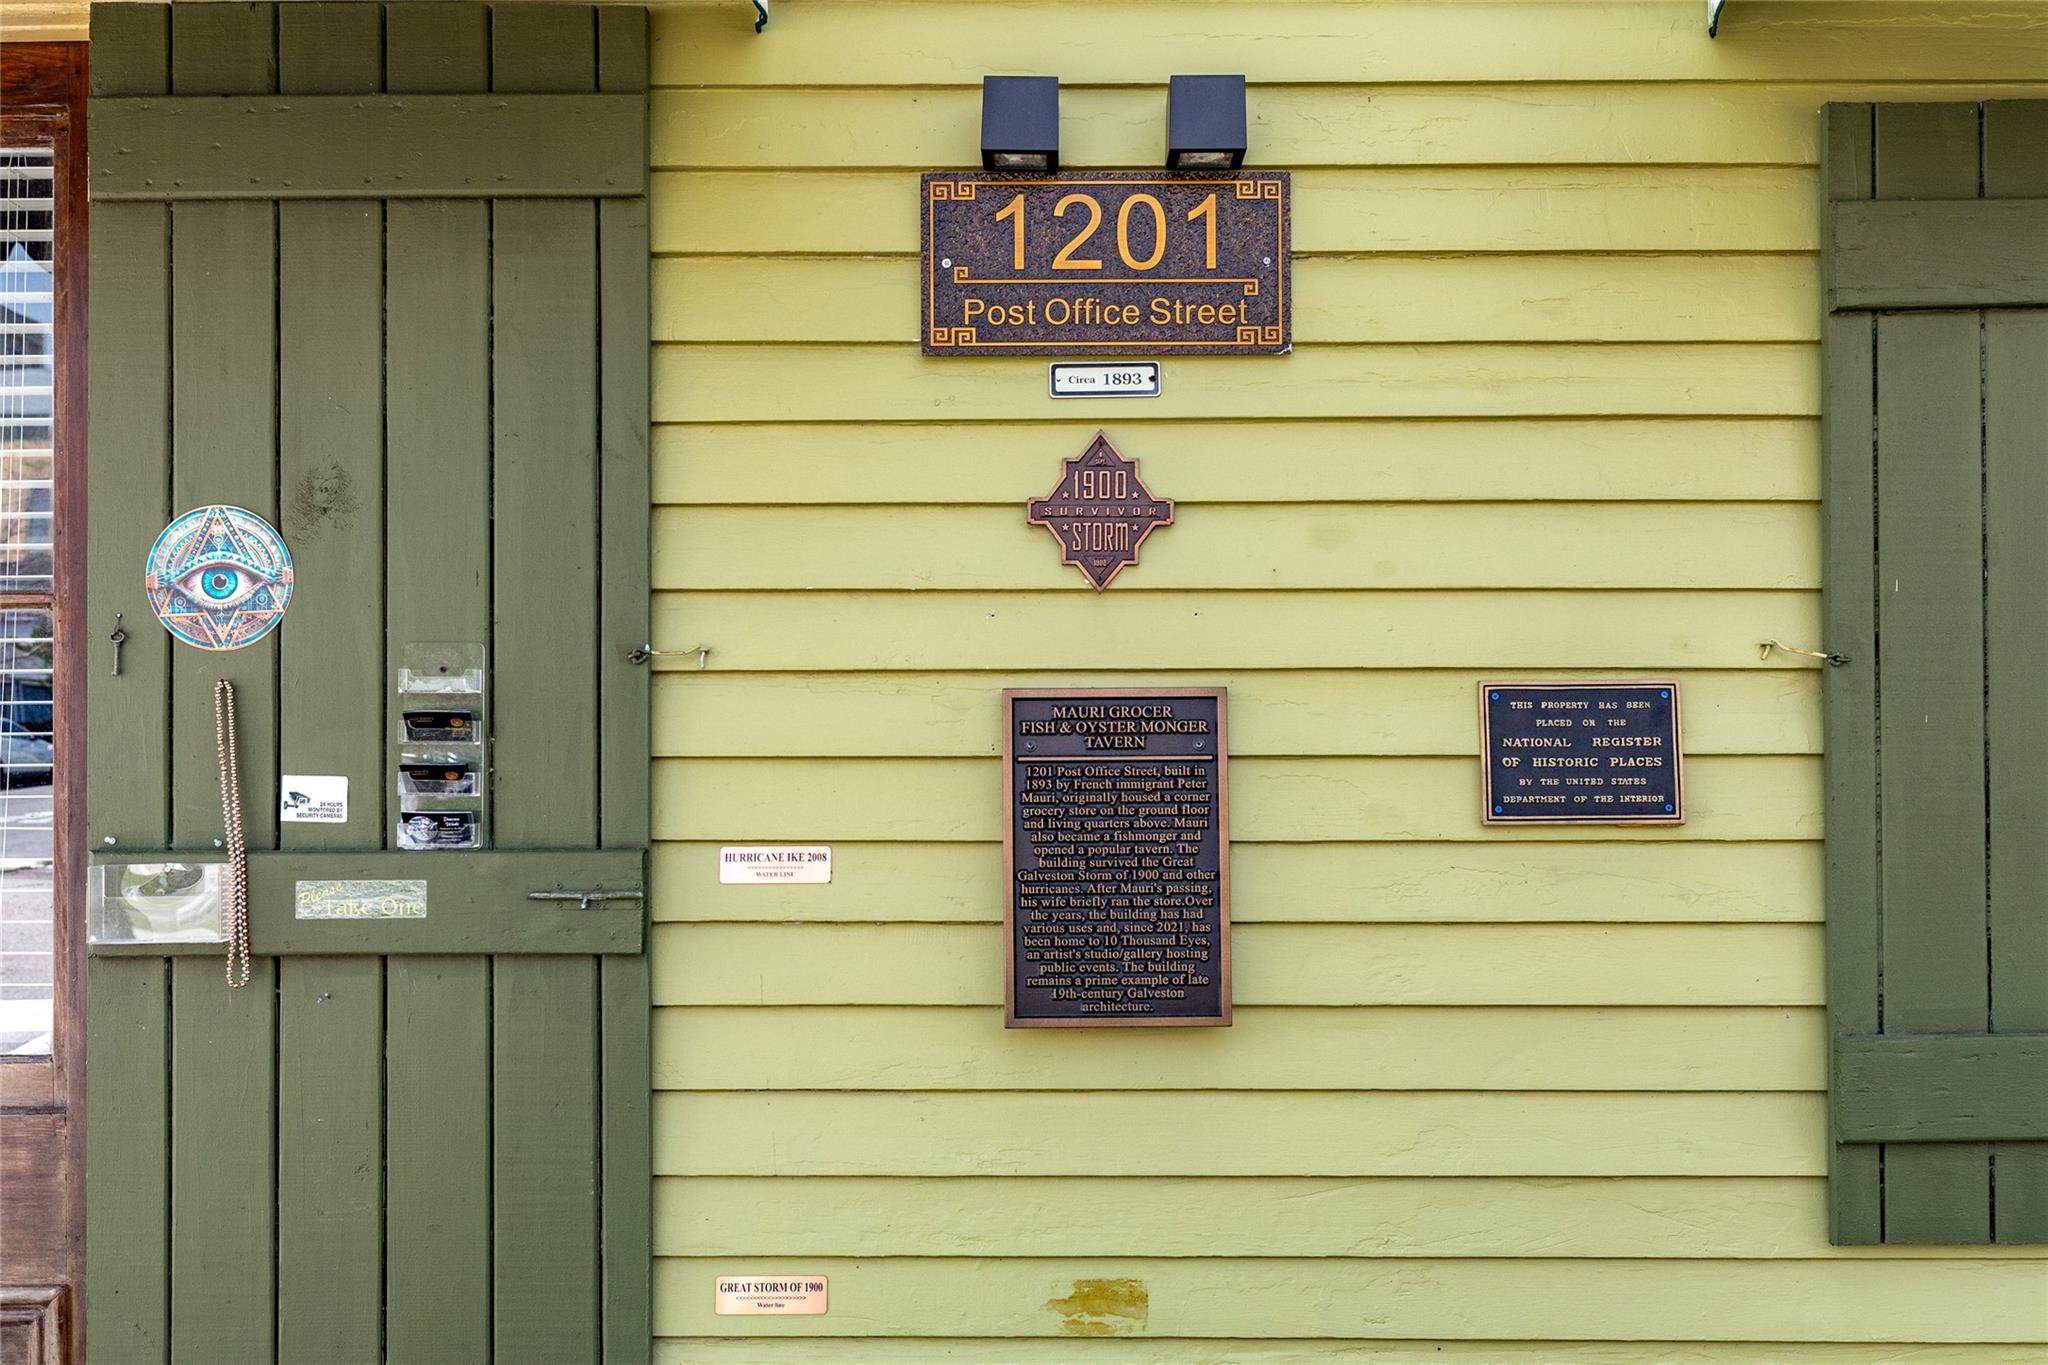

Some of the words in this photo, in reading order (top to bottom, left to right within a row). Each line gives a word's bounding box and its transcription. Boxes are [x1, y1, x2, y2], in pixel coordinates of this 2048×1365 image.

[995, 193, 1218, 270] 1201
[964, 298, 1036, 326] Post
[1045, 298, 1140, 326] Office
[1150, 298, 1248, 326] Street
[1068, 375, 1095, 385] Circa
[1103, 372, 1142, 386] 1893
[1074, 471, 1126, 499] 1900
[1073, 522, 1128, 551] STORM
[1053, 706, 1104, 718] MAURI
[1109, 706, 1172, 718] GROCER
[1021, 721, 1056, 733] FISH
[1060, 721, 1072, 733] &
[1076, 721, 1136, 733] OYSTER
[1141, 721, 1208, 733] MONGER
[1084, 736, 1145, 748] TAVERN
[1503, 738, 1572, 747] NATIONAL
[1592, 737, 1662, 746] REGISTER
[1502, 758, 1521, 767] OF
[1533, 758, 1598, 767] HISTORIC
[1610, 757, 1662, 766] PLACES
[1027, 767, 1052, 776] 1201
[1057, 767, 1081, 776] Post
[1085, 767, 1120, 776] Office
[1125, 767, 1161, 778] Street,
[1164, 766, 1190, 775] built
[1194, 766, 1204, 775] in
[1026, 780, 1051, 790] 1893
[1056, 779, 1069, 791] by
[1074, 779, 1113, 789] French
[1116, 779, 1174, 791] immigrant
[1177, 779, 1207, 788] Peter
[1022, 793, 1059, 804] Mauri,
[1063, 793, 1117, 804] originally
[1122, 792, 1160, 802] housed
[1594, 795, 1613, 803] THE
[1620, 795, 1664, 803] INTERIOR
[1023, 808, 1064, 818] grocery
[1069, 807, 1096, 815] store
[1118, 806, 1134, 815] the
[1139, 805, 1178, 817] ground
[1182, 805, 1209, 814] floor
[1024, 820, 1044, 829] and
[1048, 819, 1080, 830] living
[1084, 820, 1130, 830] quarters
[1134, 818, 1170, 827] above.
[1175, 818, 1208, 827] Mauri
[1031, 833, 1053, 842] also
[1058, 832, 1099, 841] became
[1114, 832, 1177, 843] fishmonger
[1181, 831, 1201, 840] and
[1034, 845, 1074, 856] opened
[1088, 845, 1130, 856] popular
[1135, 845, 1173, 854] tavern.
[1177, 844, 1198, 853] The
[725, 853, 784, 862] HURRICANE
[787, 853, 805, 862] IKE
[808, 853, 827, 862] 2008
[1039, 858, 1085, 870] building
[1090, 858, 1138, 867] survived
[1142, 857, 1159, 866] the
[1162, 857, 1193, 866] Great
[1018, 871, 1074, 880] Galveston
[1079, 871, 1111, 880] Storm
[1116, 870, 1129, 880] of
[1133, 870, 1158, 880] 1900
[1162, 870, 1182, 879] and
[1187, 870, 1215, 879] other
[1021, 885, 1083, 894] hurricanes.
[1087, 884, 1116, 893] After
[1120, 883, 1162, 893] Mauri's
[1166, 884, 1212, 895] passing,
[324, 900, 372, 915] Take
[382, 898, 424, 914] One
[1021, 897, 1037, 907] his
[1041, 897, 1065, 907] wife
[1070, 897, 1107, 909] briefly
[1133, 897, 1150, 906] the
[1031, 911, 1048, 920] the
[1053, 912, 1085, 922] years,
[1089, 910, 1106, 919] the
[1110, 910, 1156, 921] building
[1161, 910, 1179, 919] has
[1183, 909, 1203, 919] had
[1024, 924, 1065, 933] various
[1069, 925, 1092, 933] uses
[1097, 923, 1120, 934] and,
[1125, 923, 1153, 932] since
[1157, 922, 1188, 934] 2021,
[1192, 922, 1210, 931] has
[1024, 937, 1050, 946] been
[1054, 937, 1085, 946] home
[1089, 937, 1100, 945] to
[1104, 936, 1117, 945] 10
[1121, 936, 1176, 945] Thousand
[1180, 936, 1210, 947] Eyes,
[1044, 950, 1081, 959] artist's
[1085, 949, 1162, 961] studio/gallery
[1167, 949, 1208, 960] hosting
[1040, 963, 1075, 974] public
[1080, 963, 1118, 972] events.
[1122, 962, 1144, 972] The
[1148, 962, 1195, 973] building
[1027, 976, 1071, 985] remains
[1086, 976, 1117, 987] prime
[1122, 975, 1168, 987] example
[1173, 975, 1185, 984] of
[1189, 975, 1209, 984] late
[1053, 989, 1123, 1000] 19th-century
[1128, 988, 1184, 997] Galveston
[1082, 1002, 1153, 1012] architecture.
[720, 1283, 752, 1292] GREAT
[754, 1283, 787, 1292] STORM
[790, 1283, 803, 1292] OF
[805, 1283, 823, 1292] 1900
